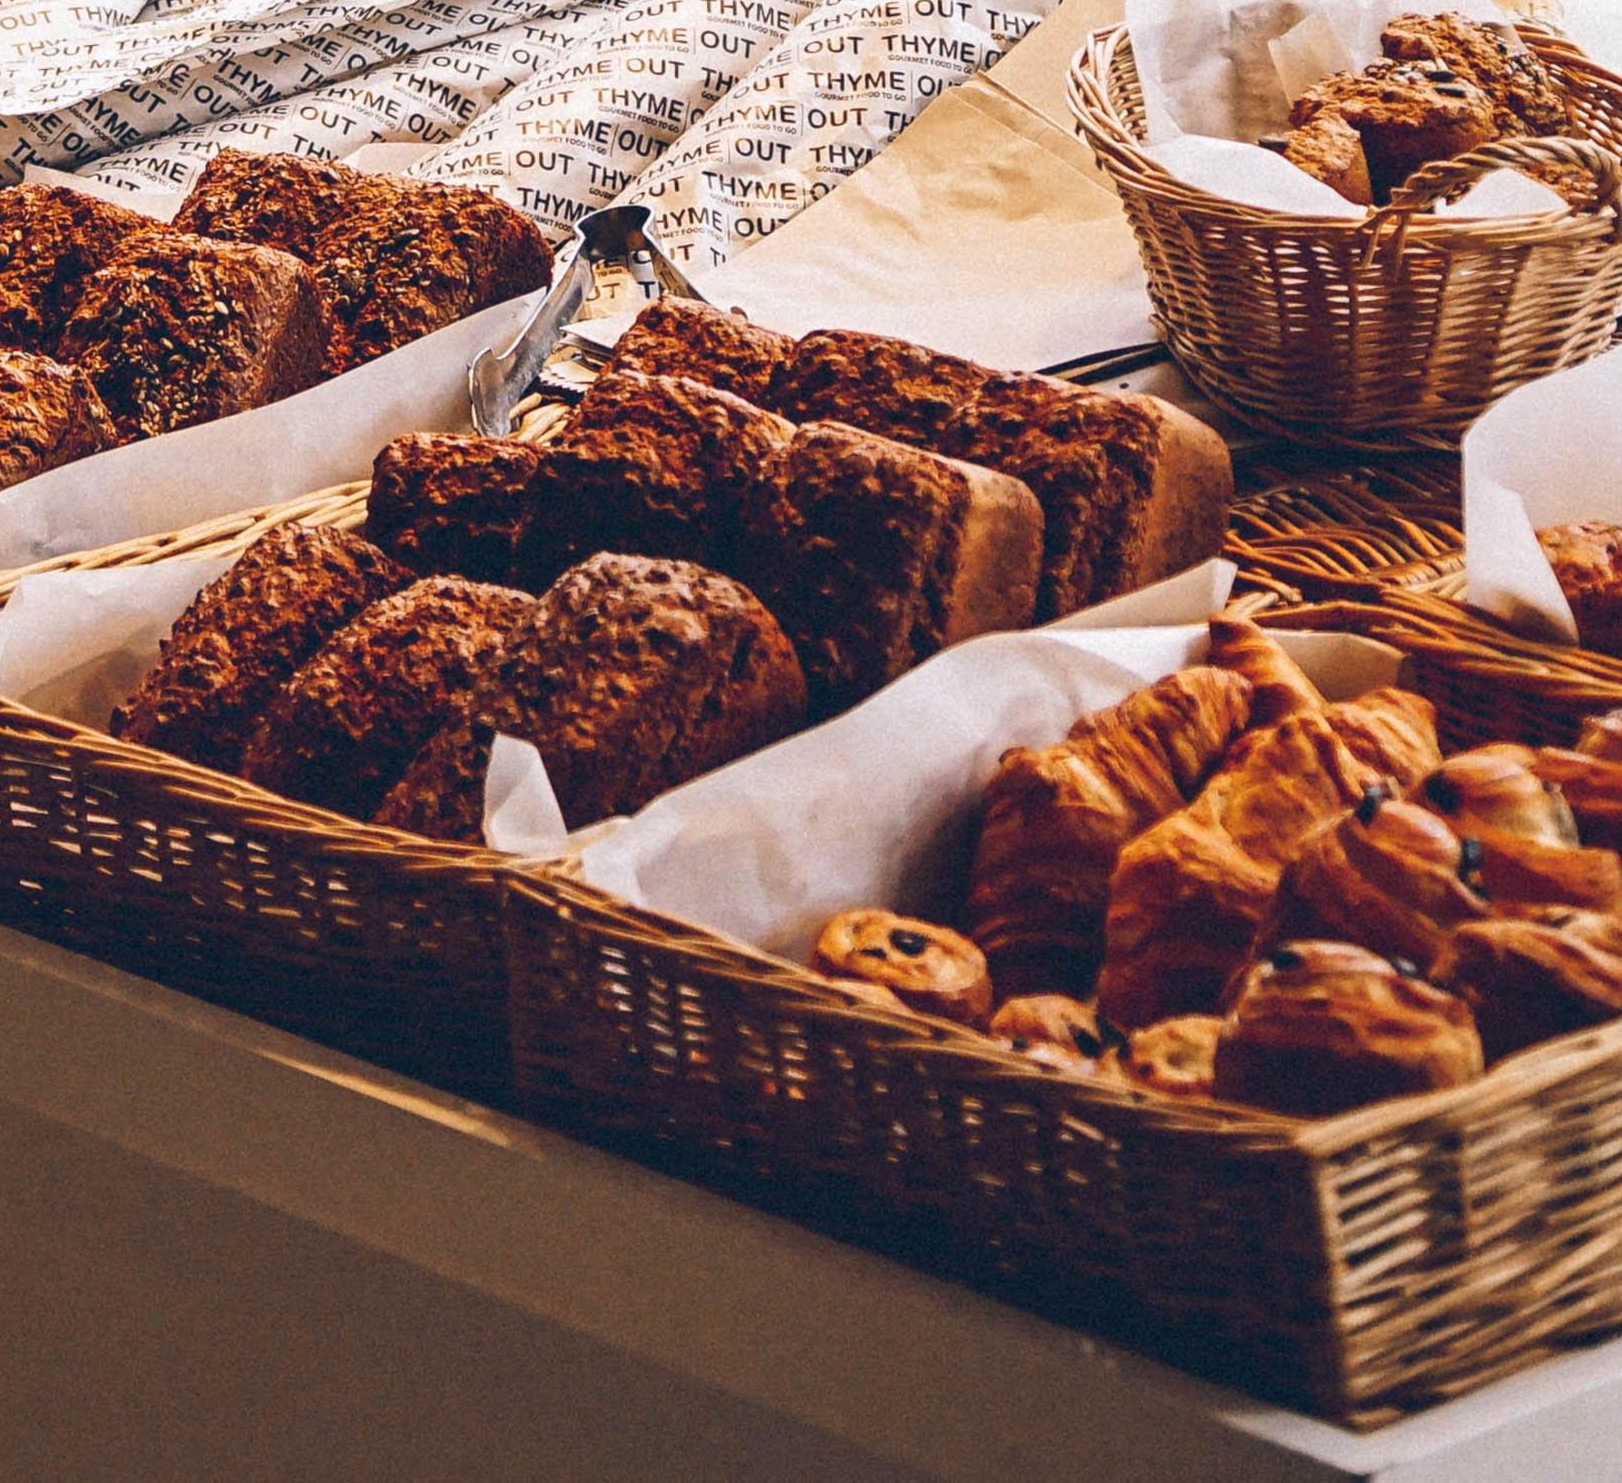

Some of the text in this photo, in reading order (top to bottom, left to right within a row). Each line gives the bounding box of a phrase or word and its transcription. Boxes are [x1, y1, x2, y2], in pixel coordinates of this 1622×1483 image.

[0, 9, 52, 30] OUT
[385, 13, 443, 35] OUT
[626, 0, 683, 22] OUT
[806, 1, 902, 31] THYME
[42, 44, 99, 58] OUT
[594, 28, 756, 59] THYME OUT
[804, 34, 977, 64] OUT THYME
[431, 55, 490, 81] OUT
[626, 58, 684, 79] OUT
[807, 70, 906, 92] THYME
[392, 71, 477, 121] THYME
[515, 87, 684, 122] OUT THYME
[218, 121, 277, 140] OUT
[300, 105, 357, 135] OUT
[408, 113, 452, 143] OUT
[638, 114, 658, 126] FOOD
[701, 104, 867, 132] THYME OUT
[516, 119, 670, 160] THYME OUT
[735, 137, 792, 164] OUT
[516, 151, 574, 175] OUT
[630, 171, 797, 205] OUT THYME
